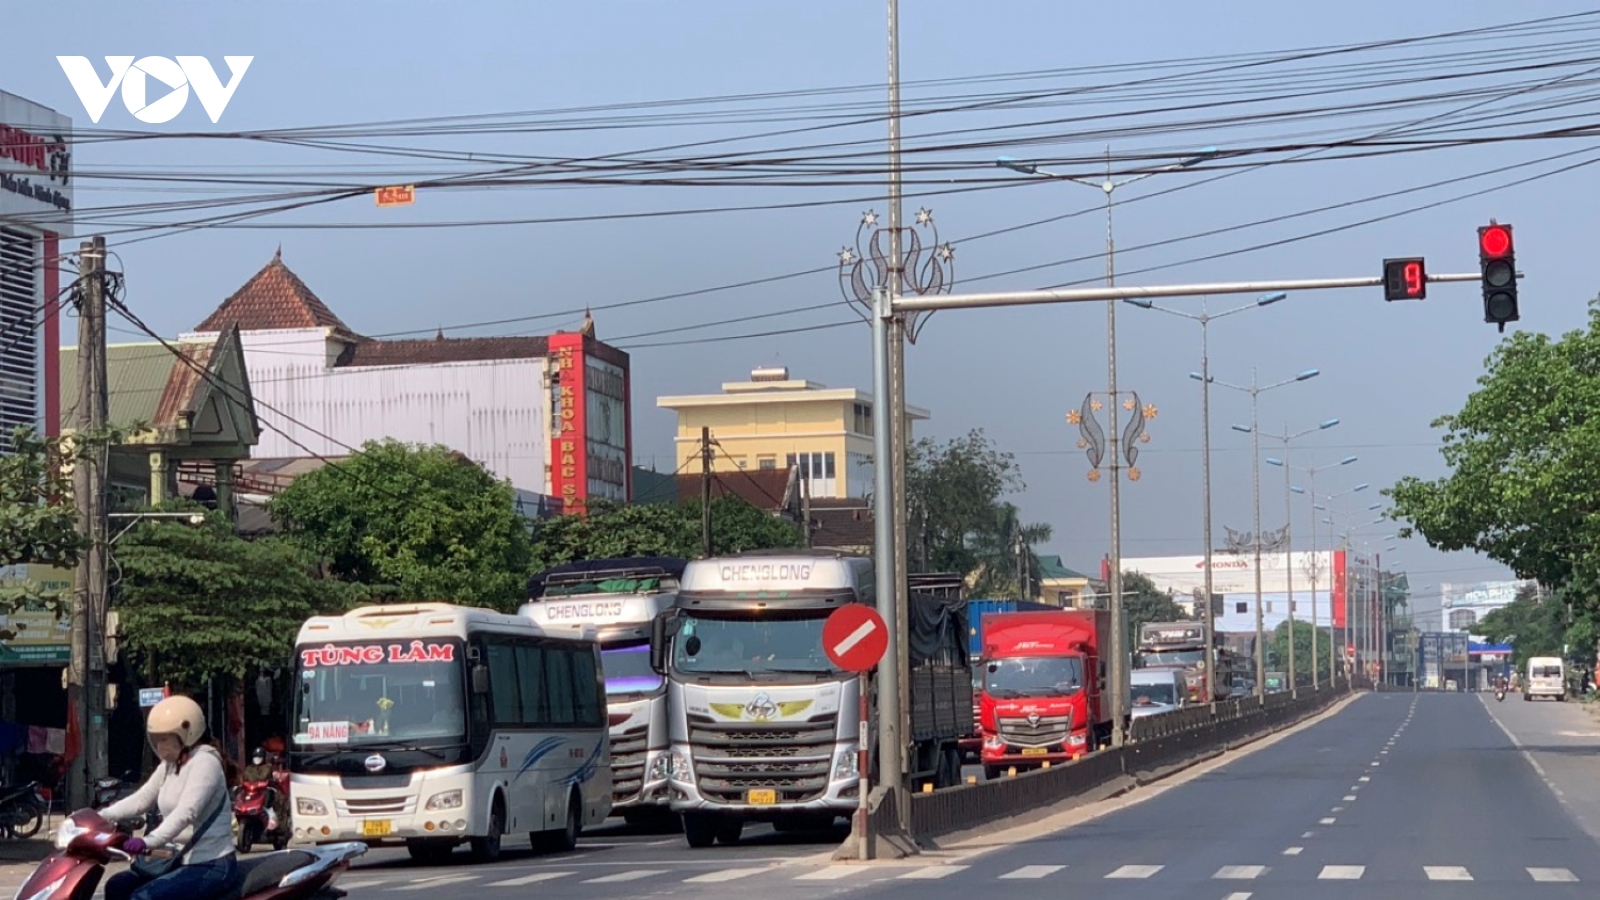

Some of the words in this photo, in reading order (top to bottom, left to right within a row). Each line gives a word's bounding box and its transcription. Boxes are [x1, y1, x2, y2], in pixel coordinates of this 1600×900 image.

[1404, 263, 1421, 294] 9
[561, 386, 575, 431] KHOA
[721, 565, 811, 582] CHENGLONG
[548, 602, 622, 620] CHENGLONG
[301, 643, 385, 667] TÙNG
[387, 640, 455, 663] LÂM
